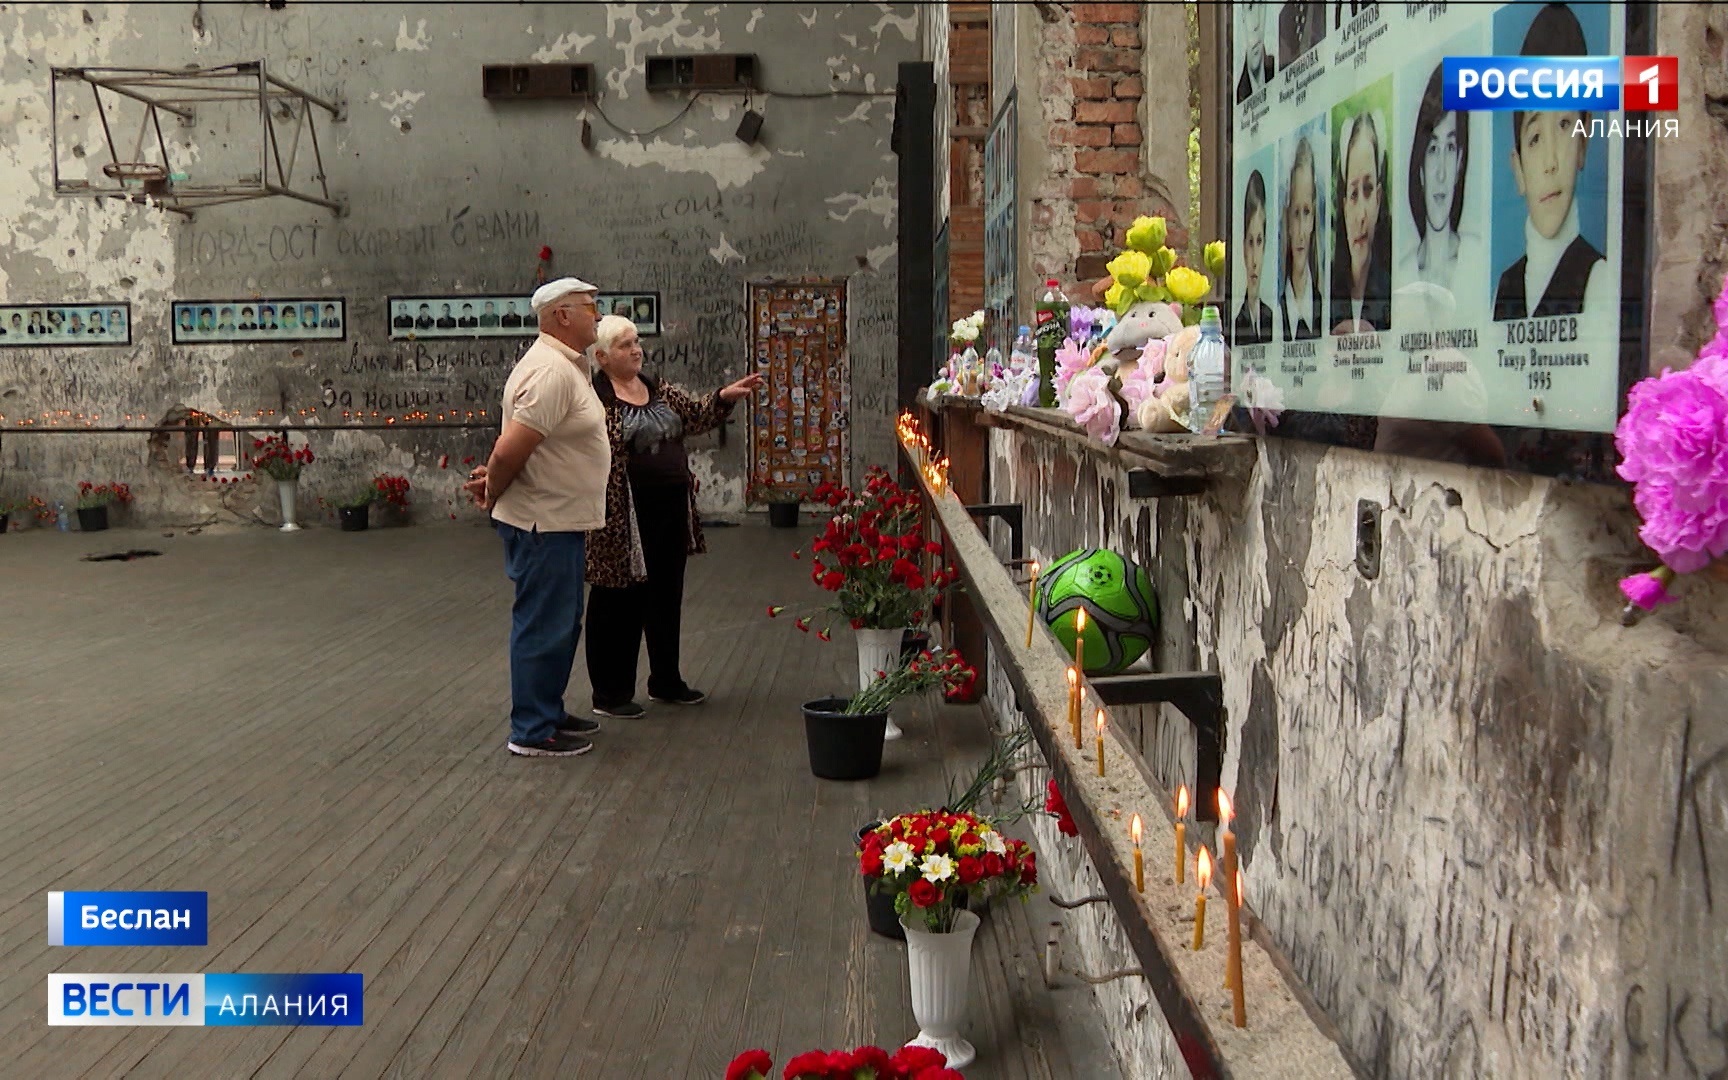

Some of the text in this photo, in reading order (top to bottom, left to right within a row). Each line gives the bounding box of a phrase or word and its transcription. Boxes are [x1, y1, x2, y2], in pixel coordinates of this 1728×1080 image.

[474, 209, 541, 243] ВАМИ
[1336, 334, 1382, 351] КОЗЫРЕВА
[1506, 317, 1578, 344] КОЗЫРЕВ
[1497, 347, 1590, 371] Тимур Витальевич
[1528, 371, 1552, 390] 1995
